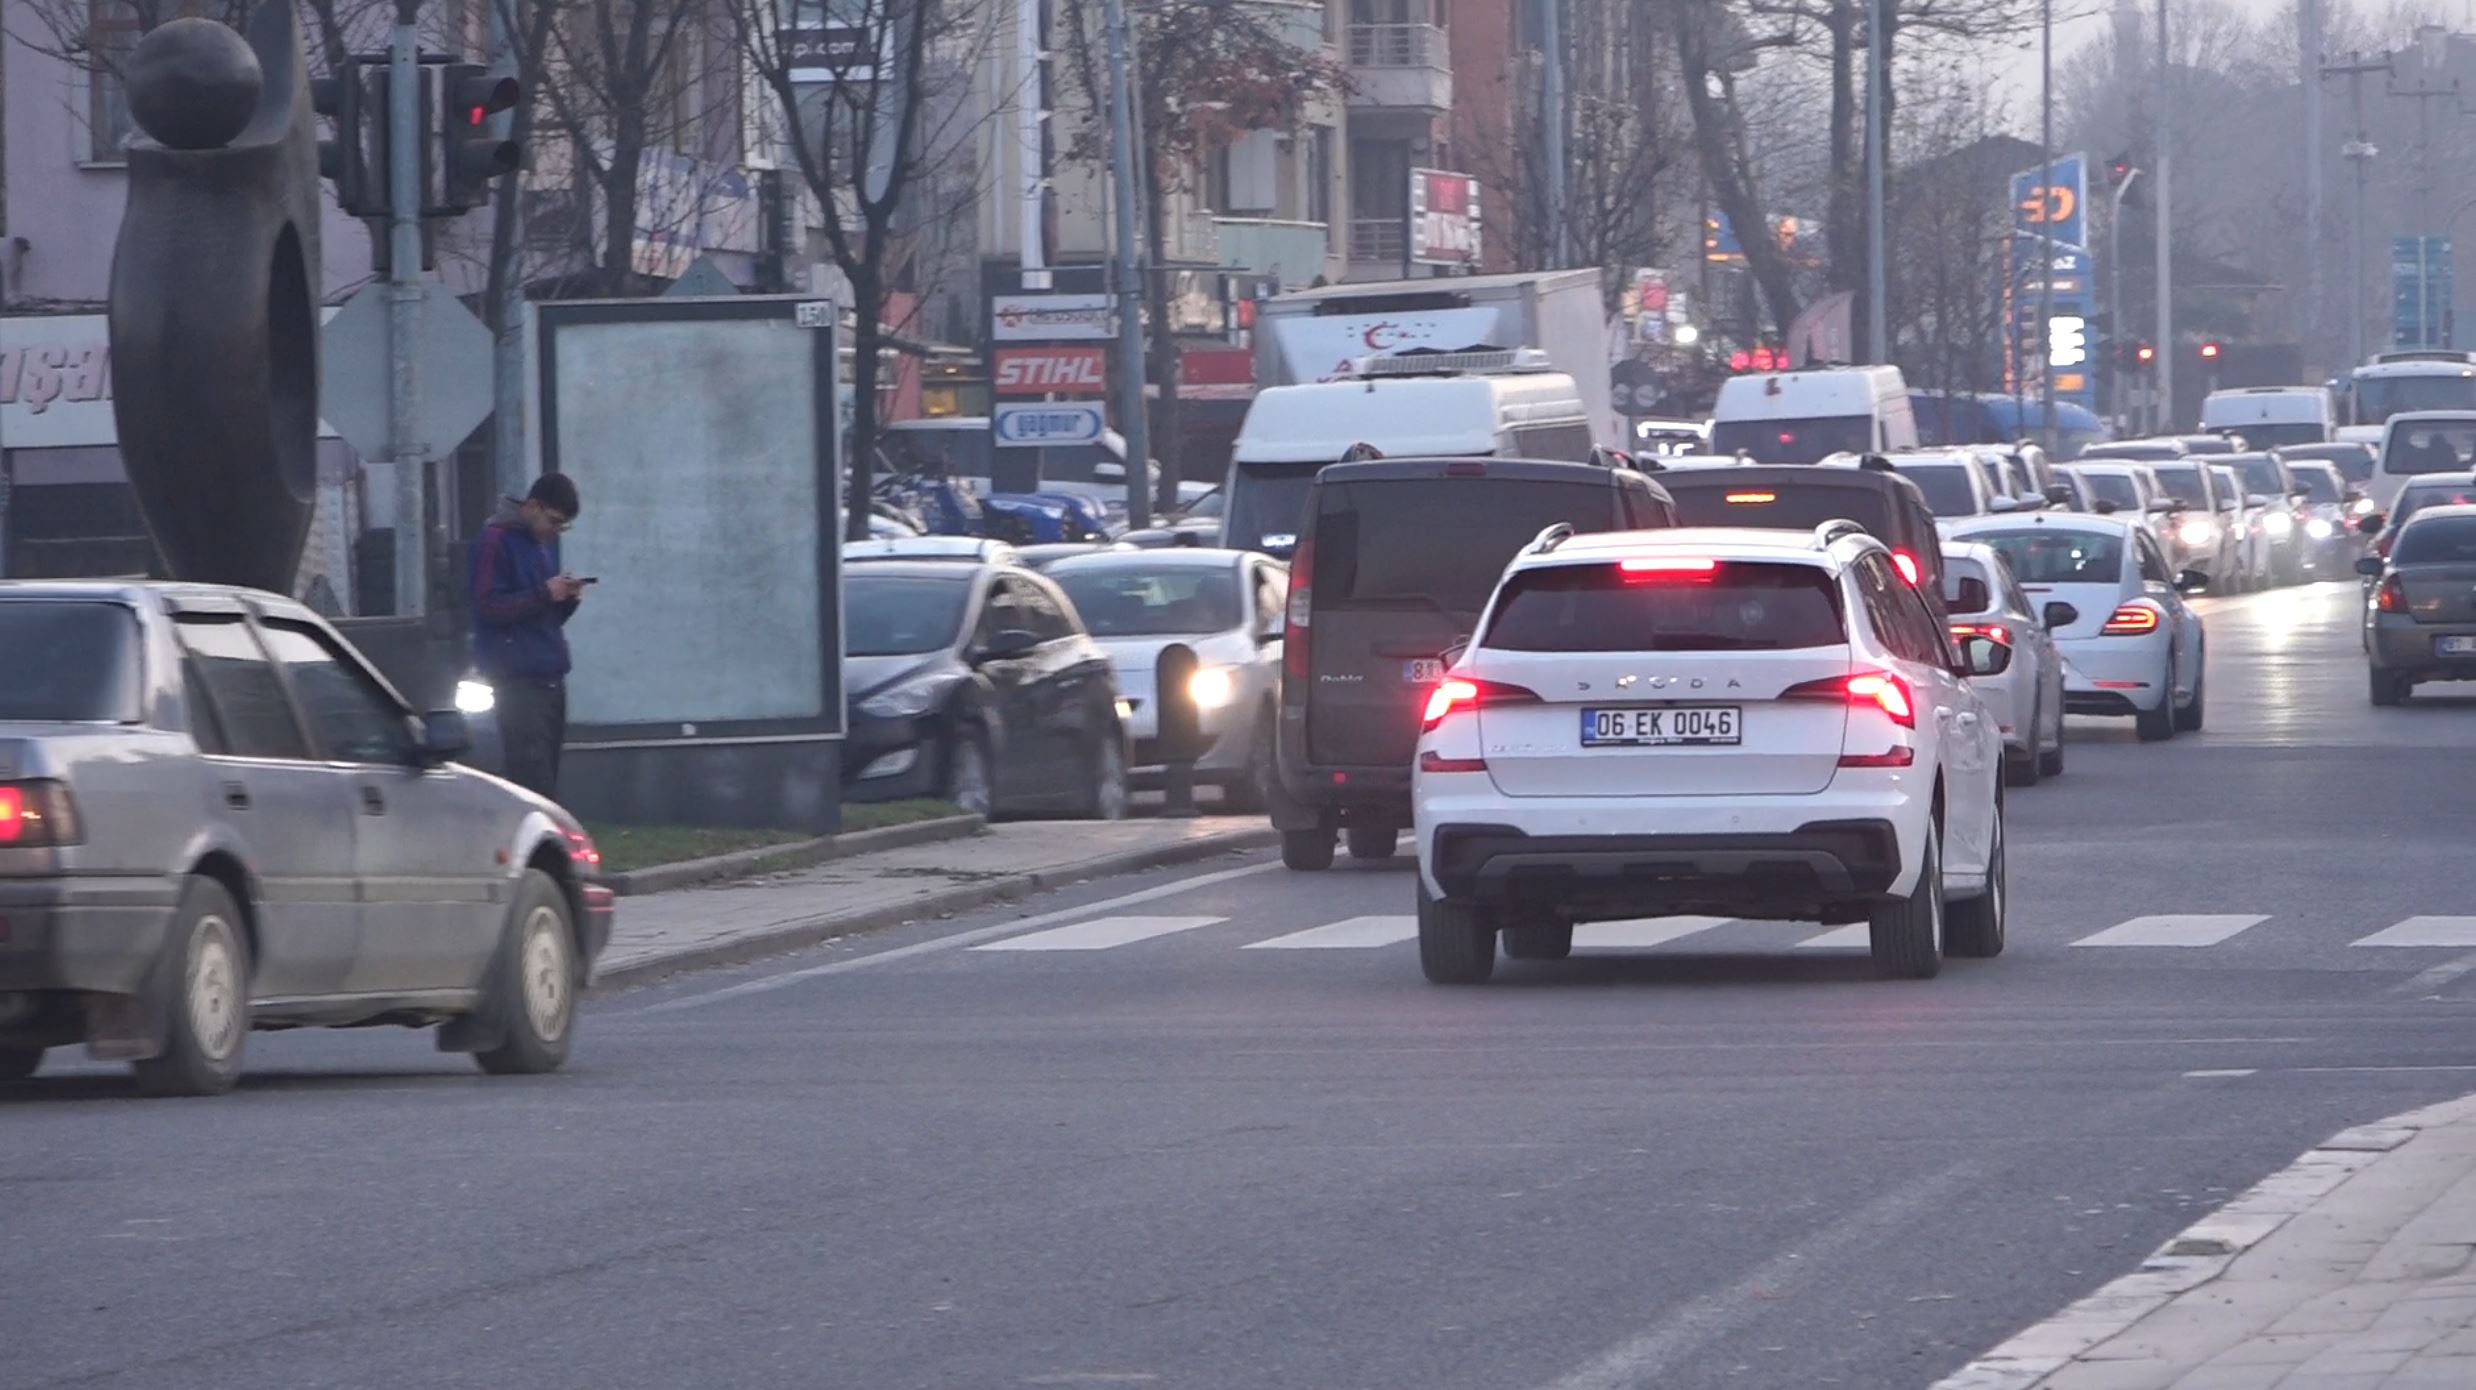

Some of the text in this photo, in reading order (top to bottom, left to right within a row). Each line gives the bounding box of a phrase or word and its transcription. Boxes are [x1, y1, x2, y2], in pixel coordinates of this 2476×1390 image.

[995, 357, 1102, 385] STIHL
[1597, 713, 1625, 736] 06
[1636, 712, 1662, 735] EK
[1674, 711, 1731, 735] 0046
